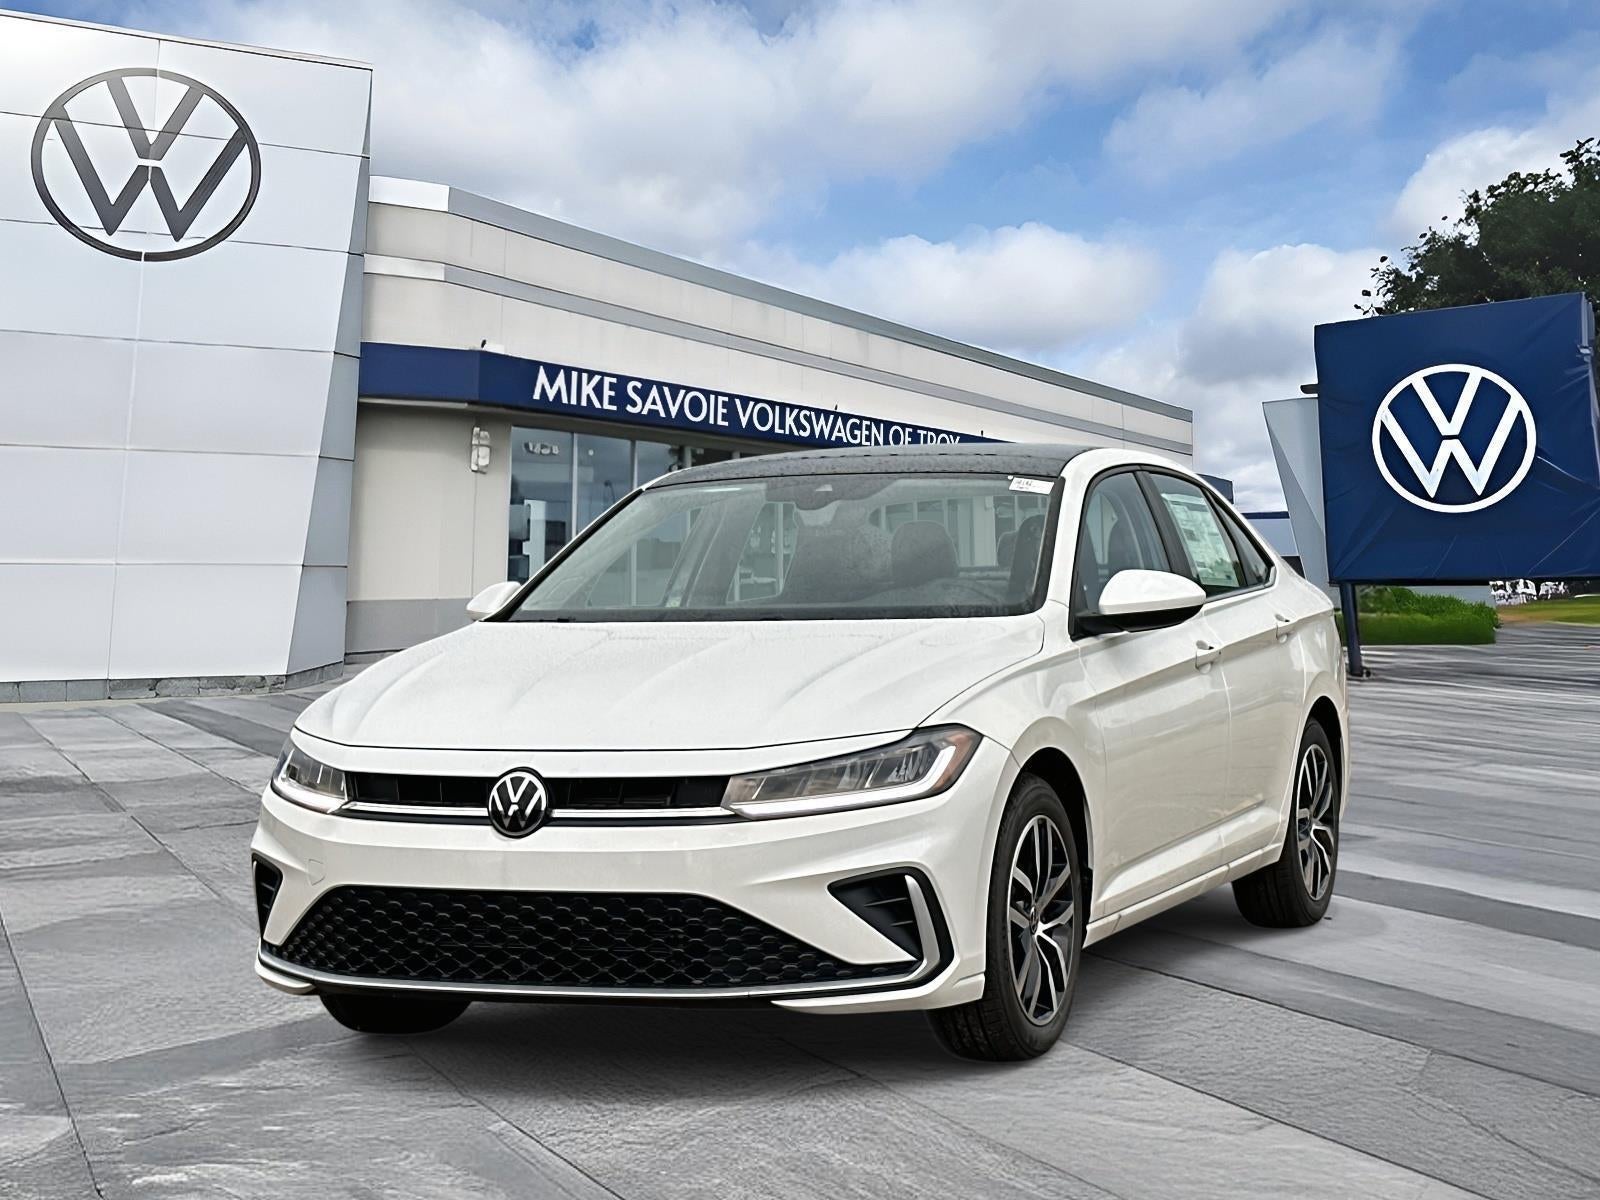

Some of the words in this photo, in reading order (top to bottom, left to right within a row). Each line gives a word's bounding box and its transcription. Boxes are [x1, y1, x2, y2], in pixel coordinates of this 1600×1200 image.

[42, 70, 253, 252] VW
[533, 366, 617, 411] MIKE
[626, 381, 729, 427] SAVOIE
[735, 398, 884, 447] VOLKSWAGEN
[888, 425, 913, 446] OF
[1376, 366, 1532, 508] VW
